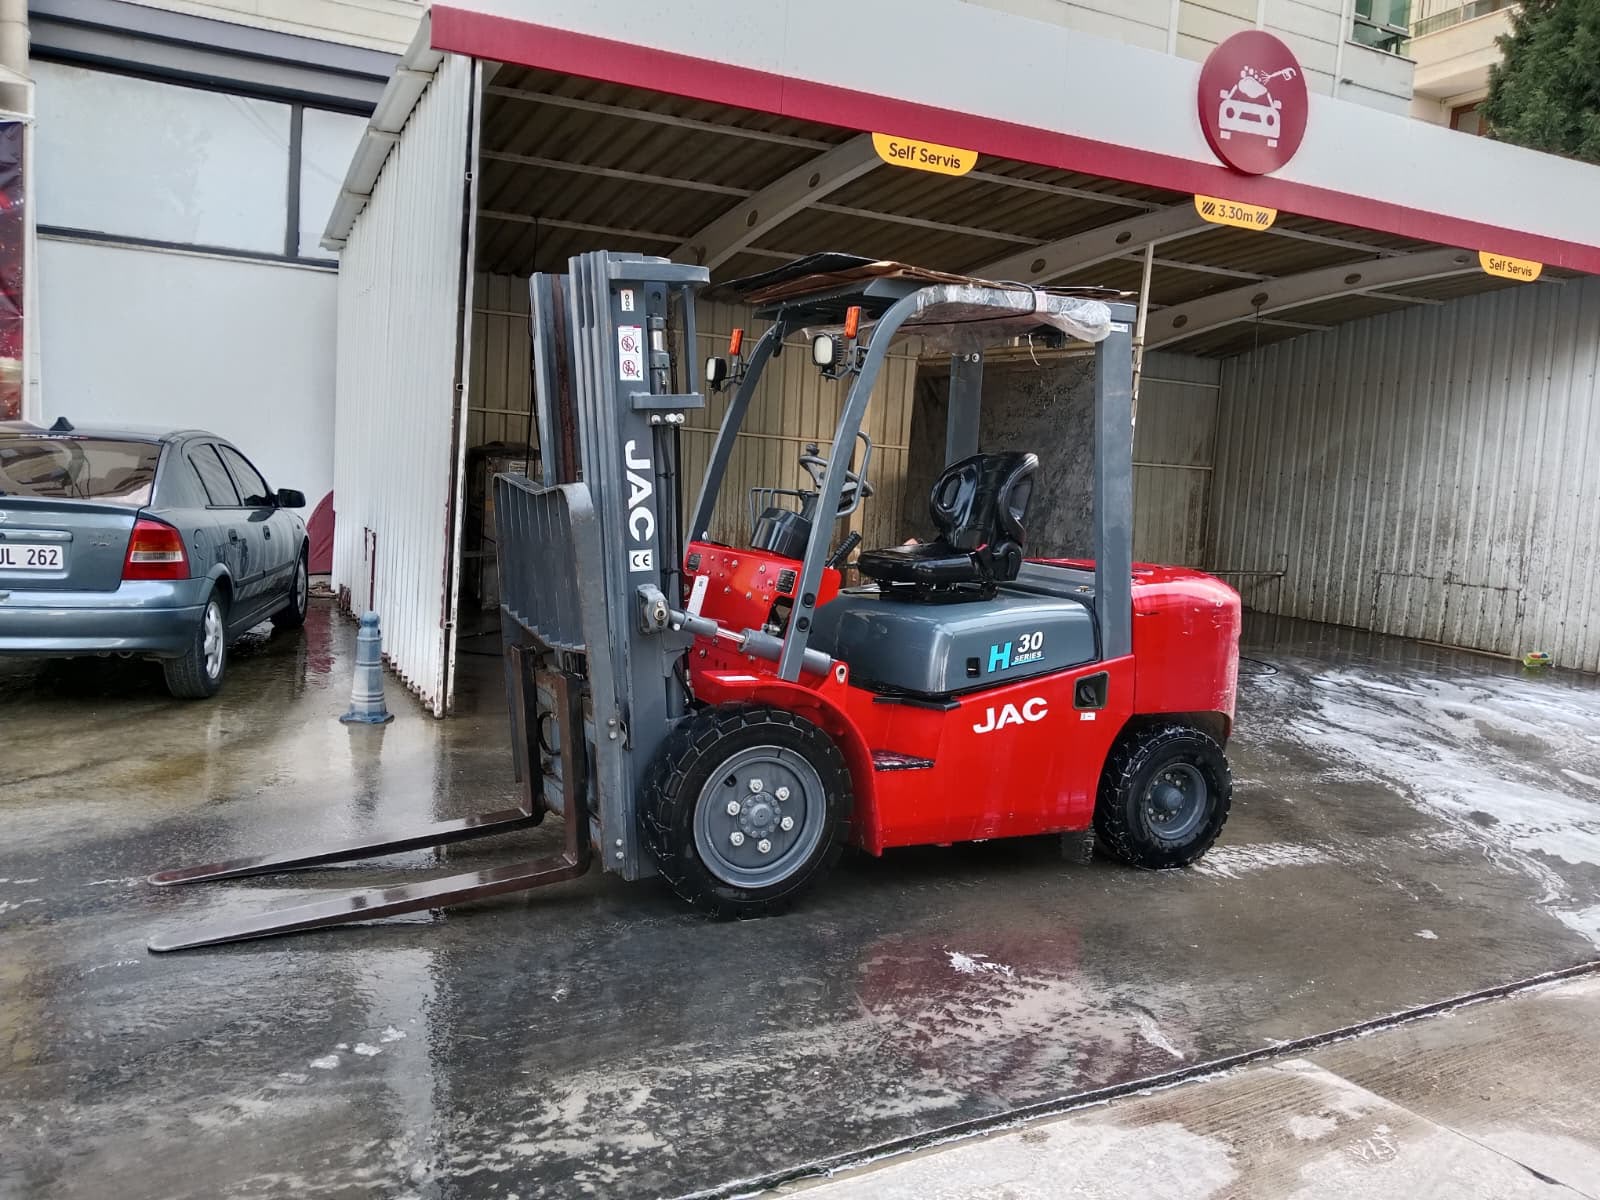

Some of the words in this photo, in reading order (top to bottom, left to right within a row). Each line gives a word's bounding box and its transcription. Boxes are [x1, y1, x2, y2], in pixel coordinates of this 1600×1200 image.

[889, 142, 917, 161] Self
[919, 148, 961, 169] Servis
[1218, 204, 1254, 223] 3.30m
[1489, 258, 1507, 271] Self
[1507, 262, 1533, 277] Servis
[624, 439, 655, 542] JAC
[27, 548, 58, 566] 262
[632, 553, 650, 568] CE
[1017, 631, 1044, 653] 30
[988, 641, 1012, 673] H
[1014, 650, 1042, 662] SERIES
[972, 697, 1049, 734] JAC
